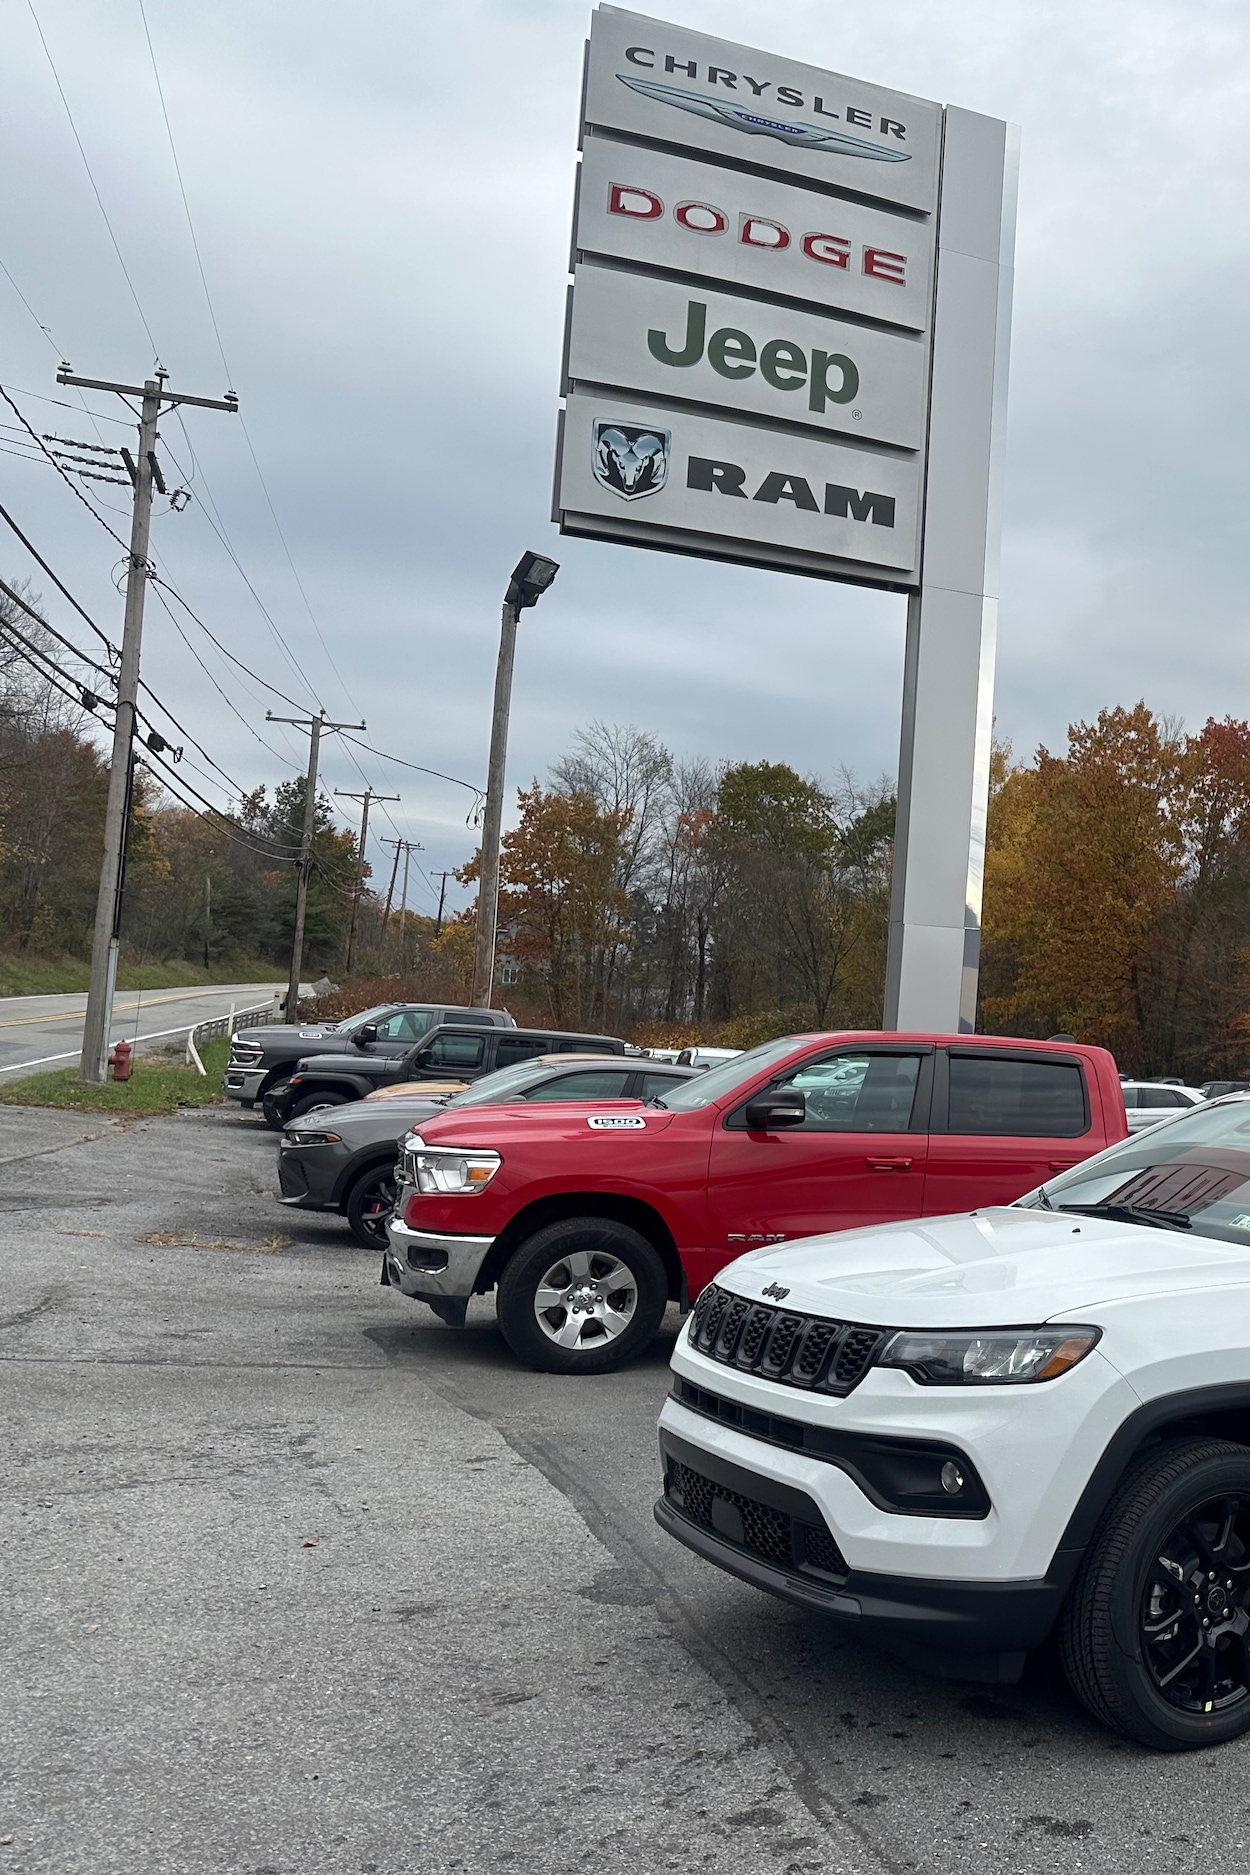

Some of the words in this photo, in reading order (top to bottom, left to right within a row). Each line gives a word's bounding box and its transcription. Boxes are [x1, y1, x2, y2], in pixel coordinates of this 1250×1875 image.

[625, 46, 907, 141] CHRYSLER
[741, 114, 799, 133] CHRYSLER
[607, 182, 907, 287] DODGE
[647, 300, 860, 413] Jeep
[687, 456, 896, 528] RAM
[727, 1233, 785, 1241] RAM
[761, 1281, 791, 1302] Jeep
